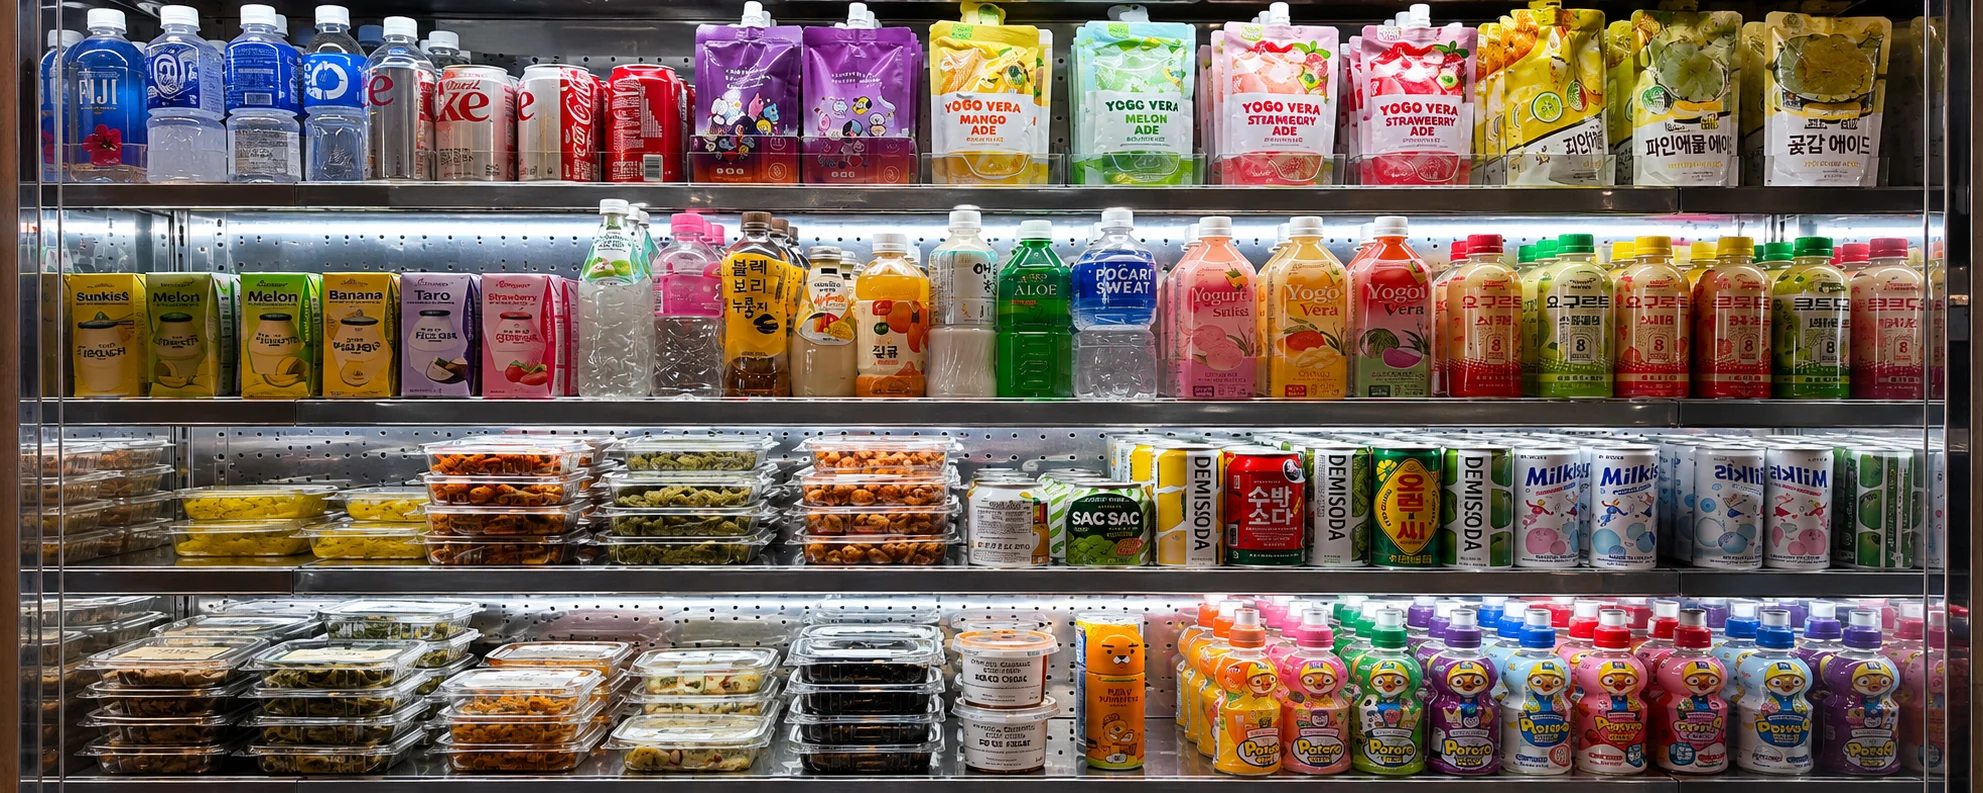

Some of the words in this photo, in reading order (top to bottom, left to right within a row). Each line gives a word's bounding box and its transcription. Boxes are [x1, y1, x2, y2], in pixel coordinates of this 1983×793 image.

[79, 79, 117, 104] FIJI
[945, 99, 983, 113] YOGO
[986, 101, 1021, 113] VERA
[1149, 101, 1179, 111] VERA
[1242, 101, 1283, 113] YOGO
[1288, 103, 1320, 115] VERA
[1380, 102, 1422, 115] YOGO
[1426, 104, 1458, 115] VERA
[960, 115, 1006, 124] MANGO
[1125, 114, 1167, 123] MELON
[971, 126, 996, 135] ADE
[1134, 125, 1159, 134] ADE
[1272, 126, 1297, 135] ADE
[1410, 127, 1434, 136] ADE
[733, 279, 766, 293] 보리
[1014, 284, 1057, 296] ALOE
[1096, 281, 1150, 294] SWEAT
[153, 291, 200, 302] Melon
[247, 290, 298, 302] Melon
[329, 290, 383, 300] Banana
[414, 290, 451, 301] Taro
[1285, 284, 1340, 304] Yogo
[1300, 304, 1338, 316] Vera
[1491, 339, 1500, 351] 8
[1576, 339, 1586, 351] 8
[1654, 339, 1664, 351] 8
[1744, 340, 1754, 351] 8
[1826, 341, 1835, 353] 8
[1900, 342, 1908, 353] 8
[1600, 463, 1659, 486] Milkis
[1248, 486, 1292, 508] 수박
[1328, 454, 1346, 541] DEMISODA
[1072, 511, 1105, 525] SAC
[1107, 511, 1140, 525] SAC
[1248, 508, 1294, 525] 소다
